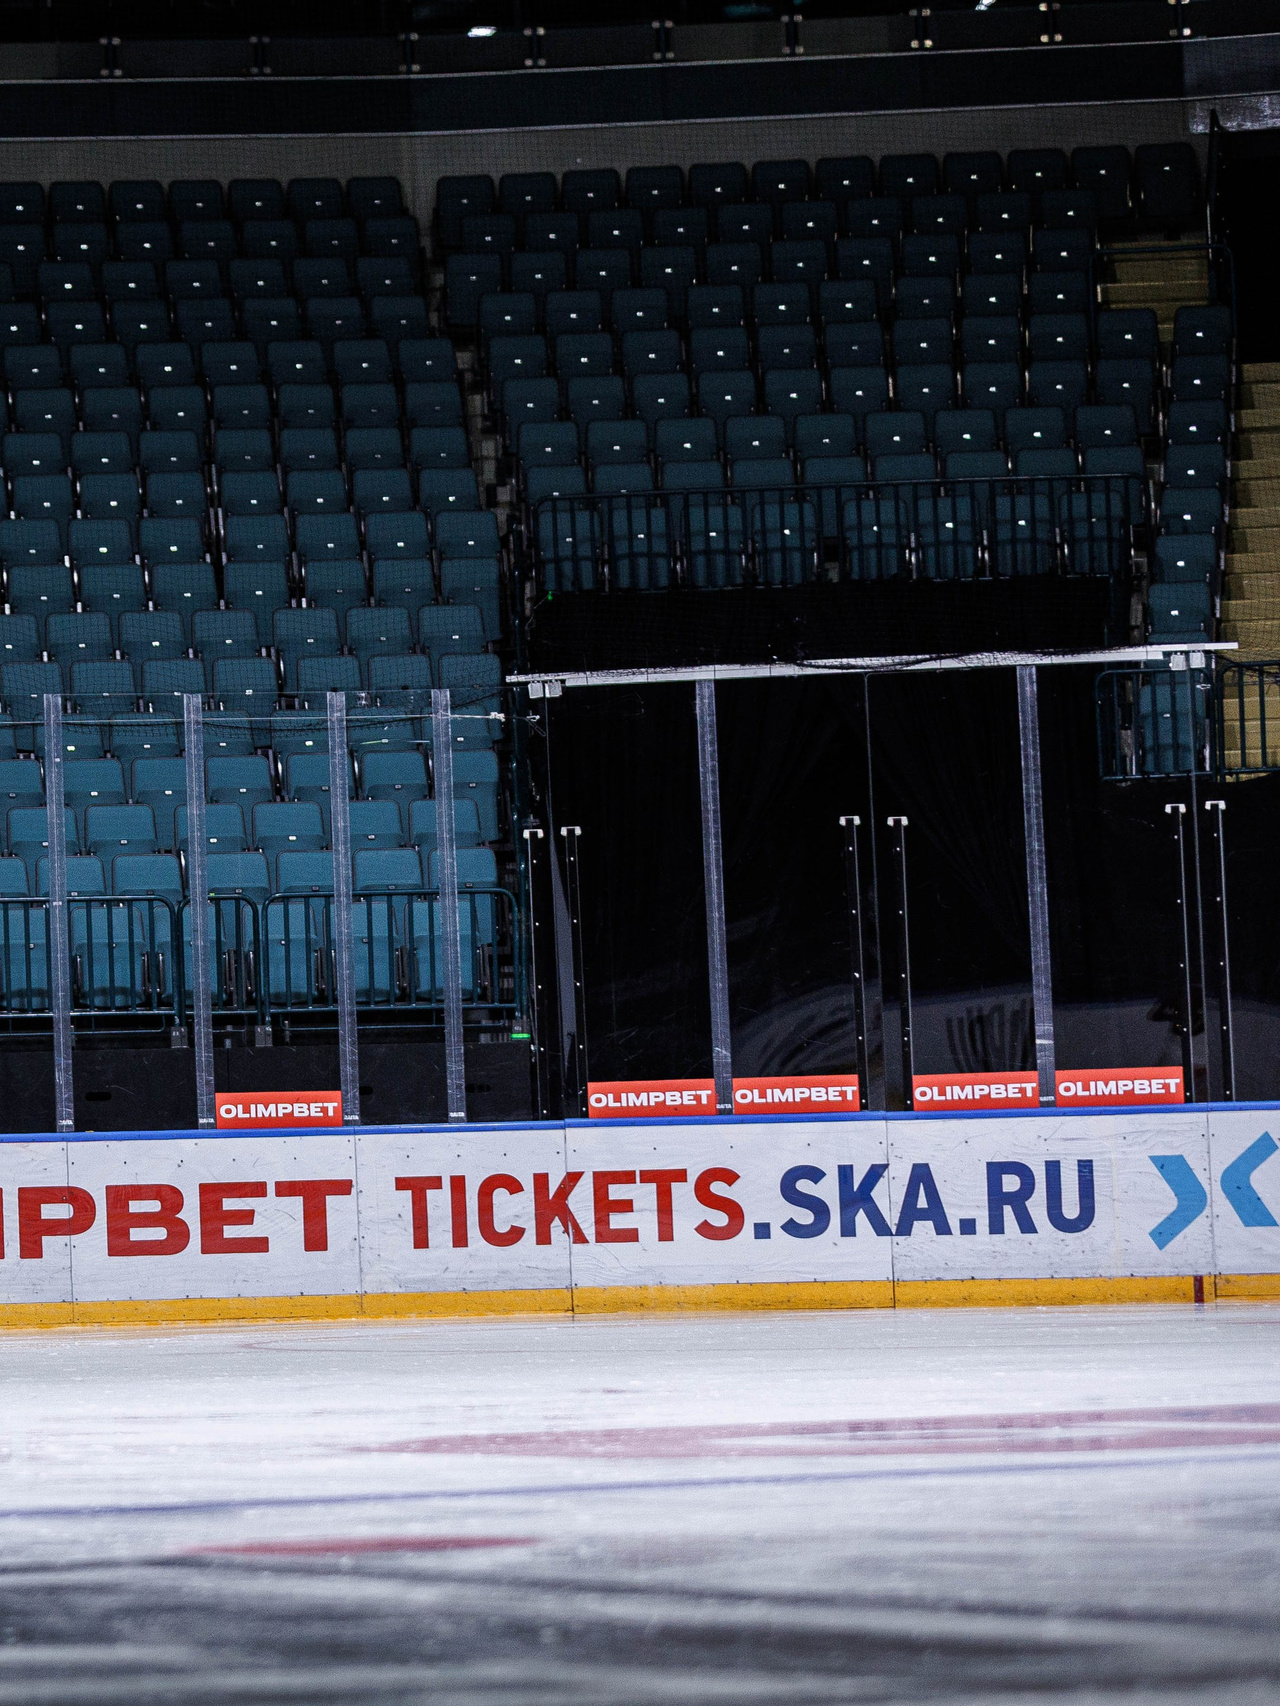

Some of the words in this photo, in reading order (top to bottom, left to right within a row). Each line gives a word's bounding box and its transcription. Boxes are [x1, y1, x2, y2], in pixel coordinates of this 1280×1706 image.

[734, 1085, 858, 1105] OLIMPBET
[914, 1082, 1037, 1102] OLIMPBET
[1058, 1078, 1181, 1097] OLIMPBET
[589, 1089, 712, 1109] OLIMPBET
[219, 1101, 339, 1119] OLIMPBET
[394, 1158, 1096, 1250] TICKETS.SKA.RU
